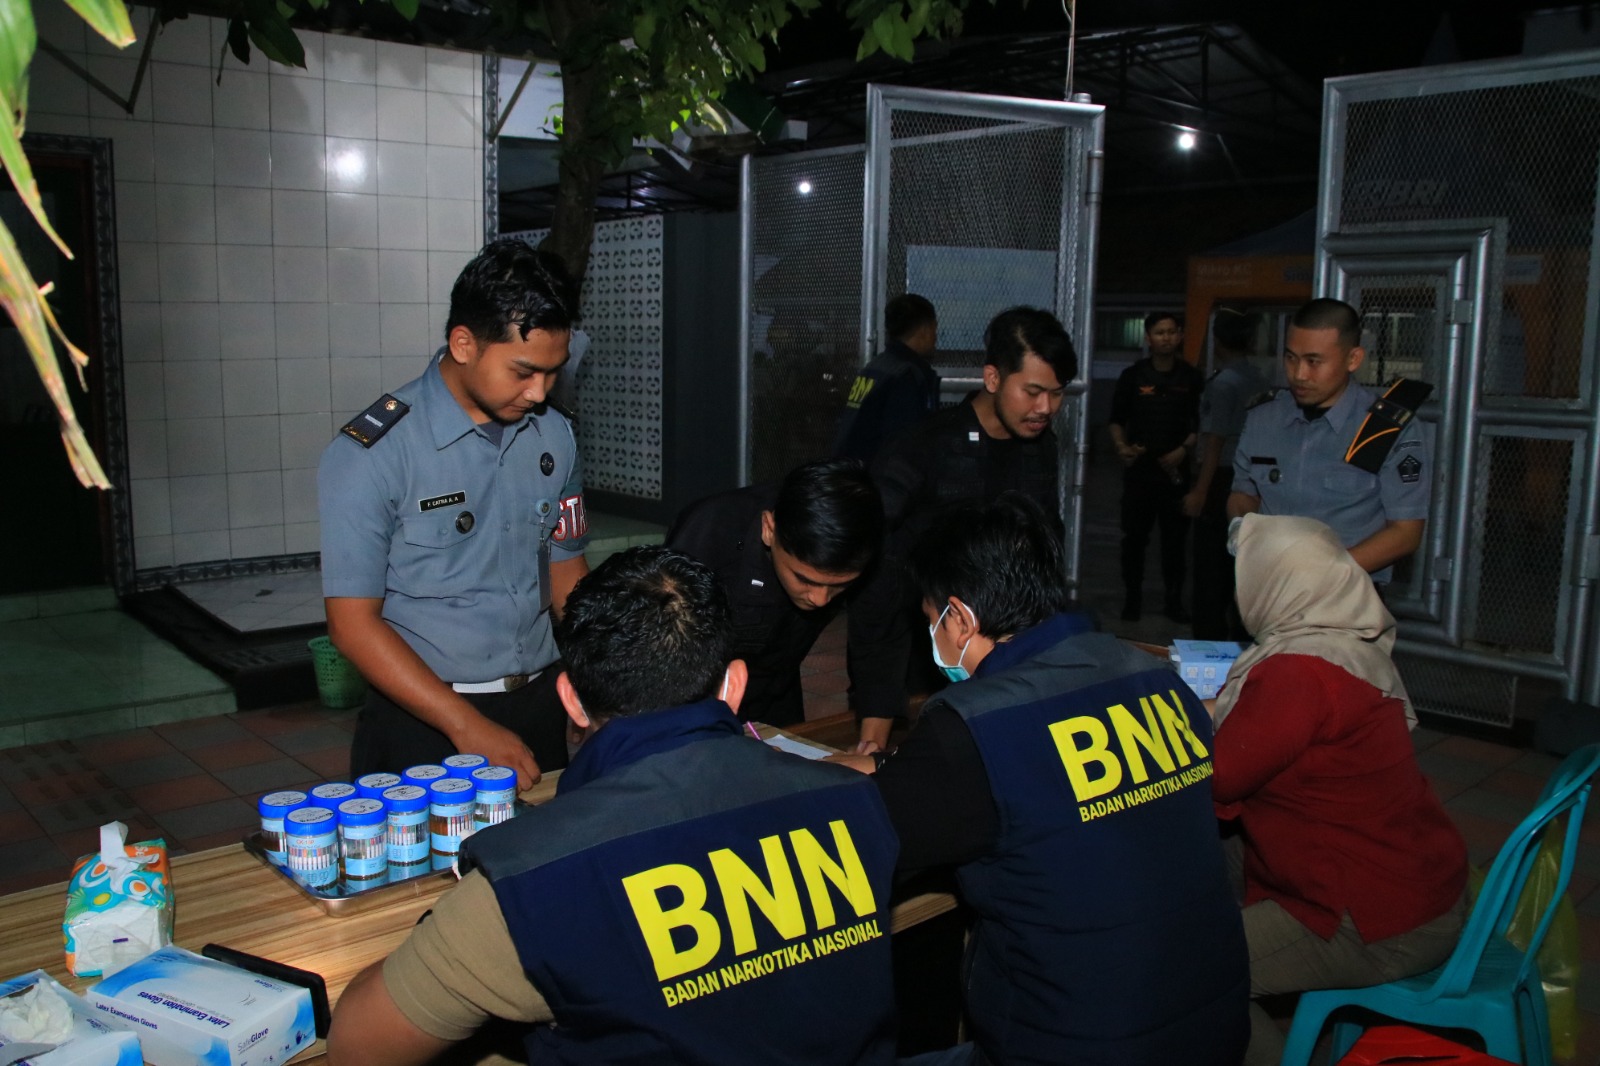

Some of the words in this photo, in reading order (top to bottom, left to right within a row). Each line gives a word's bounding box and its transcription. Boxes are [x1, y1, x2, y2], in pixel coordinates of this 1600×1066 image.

[1048, 689, 1209, 803] BNN
[1078, 794, 1126, 823] BADAN
[1123, 774, 1183, 808] NARKOTIKA
[621, 819, 877, 982] BNN
[661, 970, 721, 1008] BADAN
[719, 942, 814, 989] NARKOTIKA
[814, 919, 883, 958] NASIONAL
[138, 991, 163, 1005] Gloves
[162, 998, 208, 1021] Examination
[95, 1002, 109, 1012] Latex
[110, 1004, 140, 1024] Examination
[140, 1015, 158, 1030] Gloves
[206, 1015, 230, 1029] Latex
[237, 1027, 269, 1052] SafeGlove
